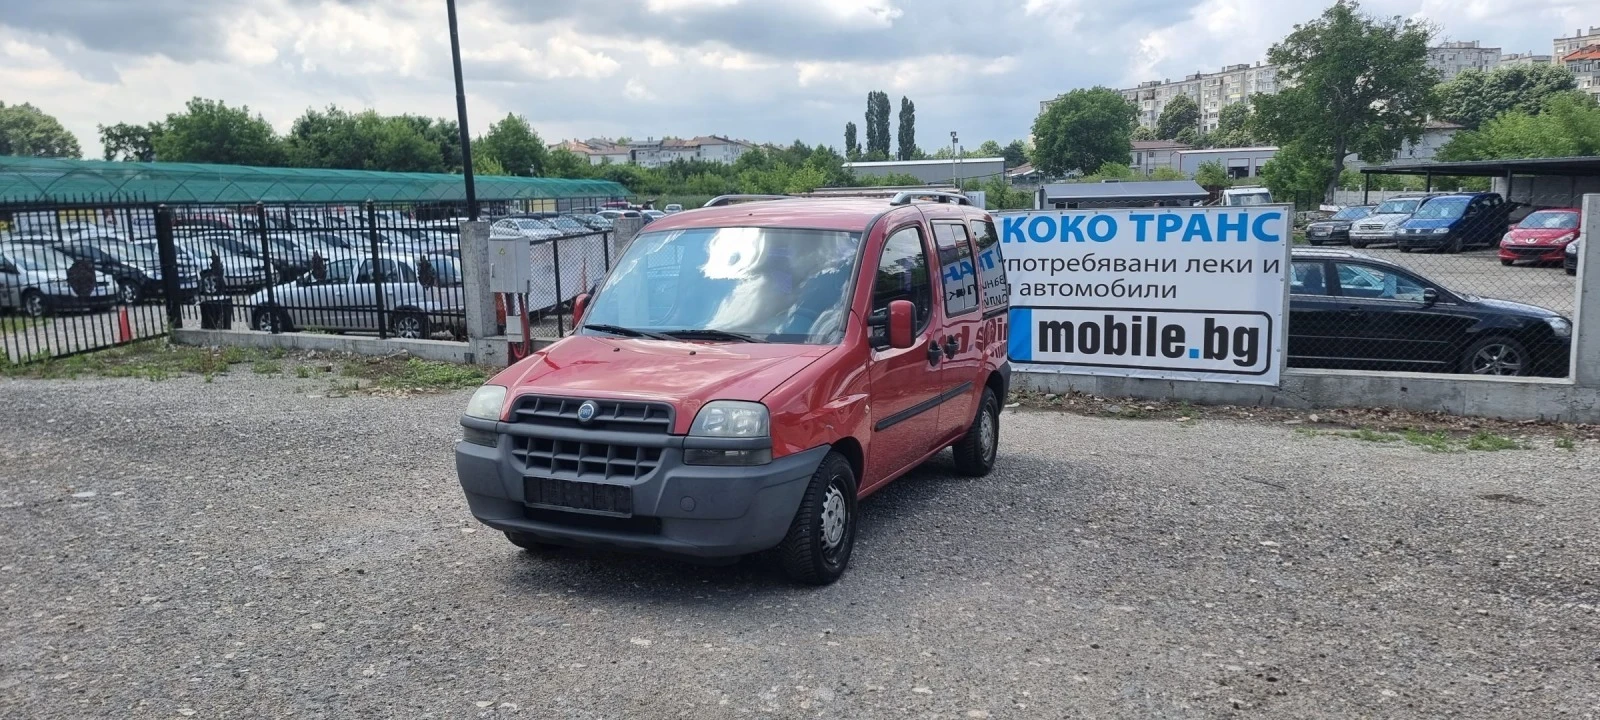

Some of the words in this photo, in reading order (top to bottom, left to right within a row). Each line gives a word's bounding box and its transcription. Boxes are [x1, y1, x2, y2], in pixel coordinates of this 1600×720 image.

[1003, 214, 1118, 243] КОКО
[1129, 212, 1282, 243] ТРАНС
[1003, 253, 1177, 277] потребявани
[1185, 258, 1253, 274] леки
[1263, 258, 1280, 274] и
[1019, 278, 1177, 299] автомобили
[1038, 314, 1260, 368] mobile.bg
